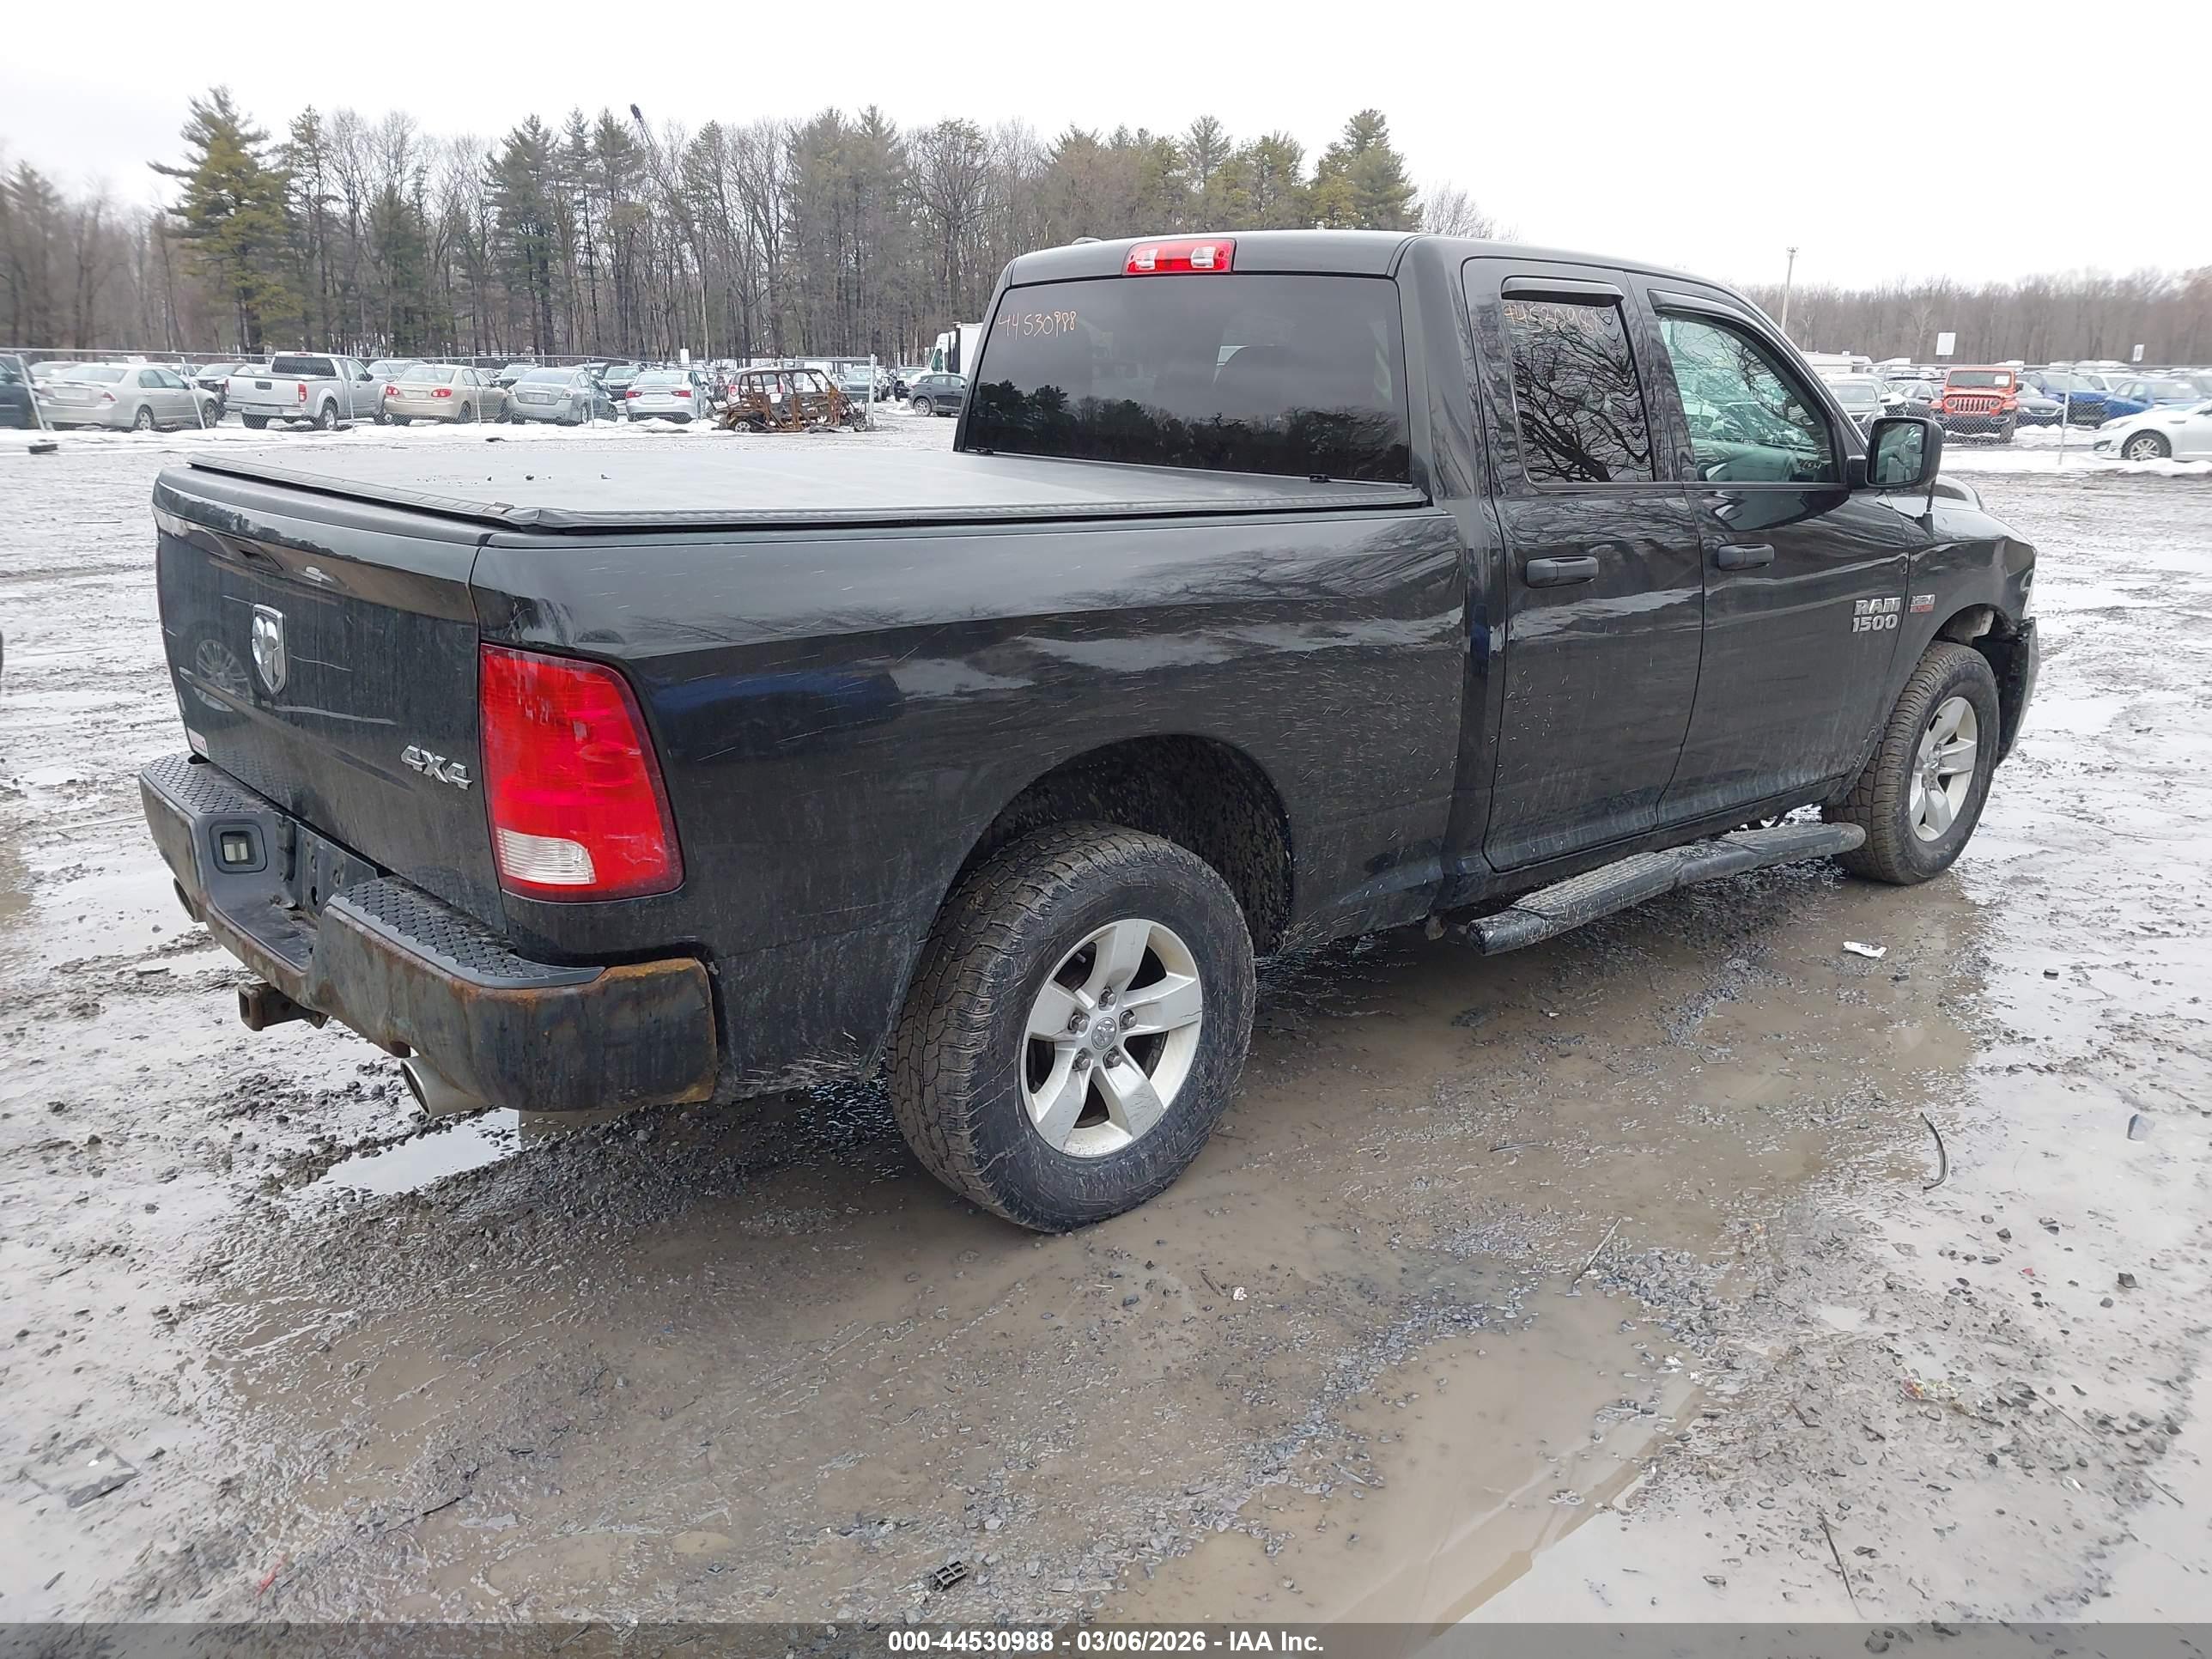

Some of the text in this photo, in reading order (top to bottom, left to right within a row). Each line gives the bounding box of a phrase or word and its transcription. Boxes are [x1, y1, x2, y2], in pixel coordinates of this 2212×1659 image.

[997, 310, 1077, 341] 44530988
[1504, 303, 1605, 335] 44530988
[1854, 598, 1901, 615] RAM
[1852, 615, 1898, 633] 1500
